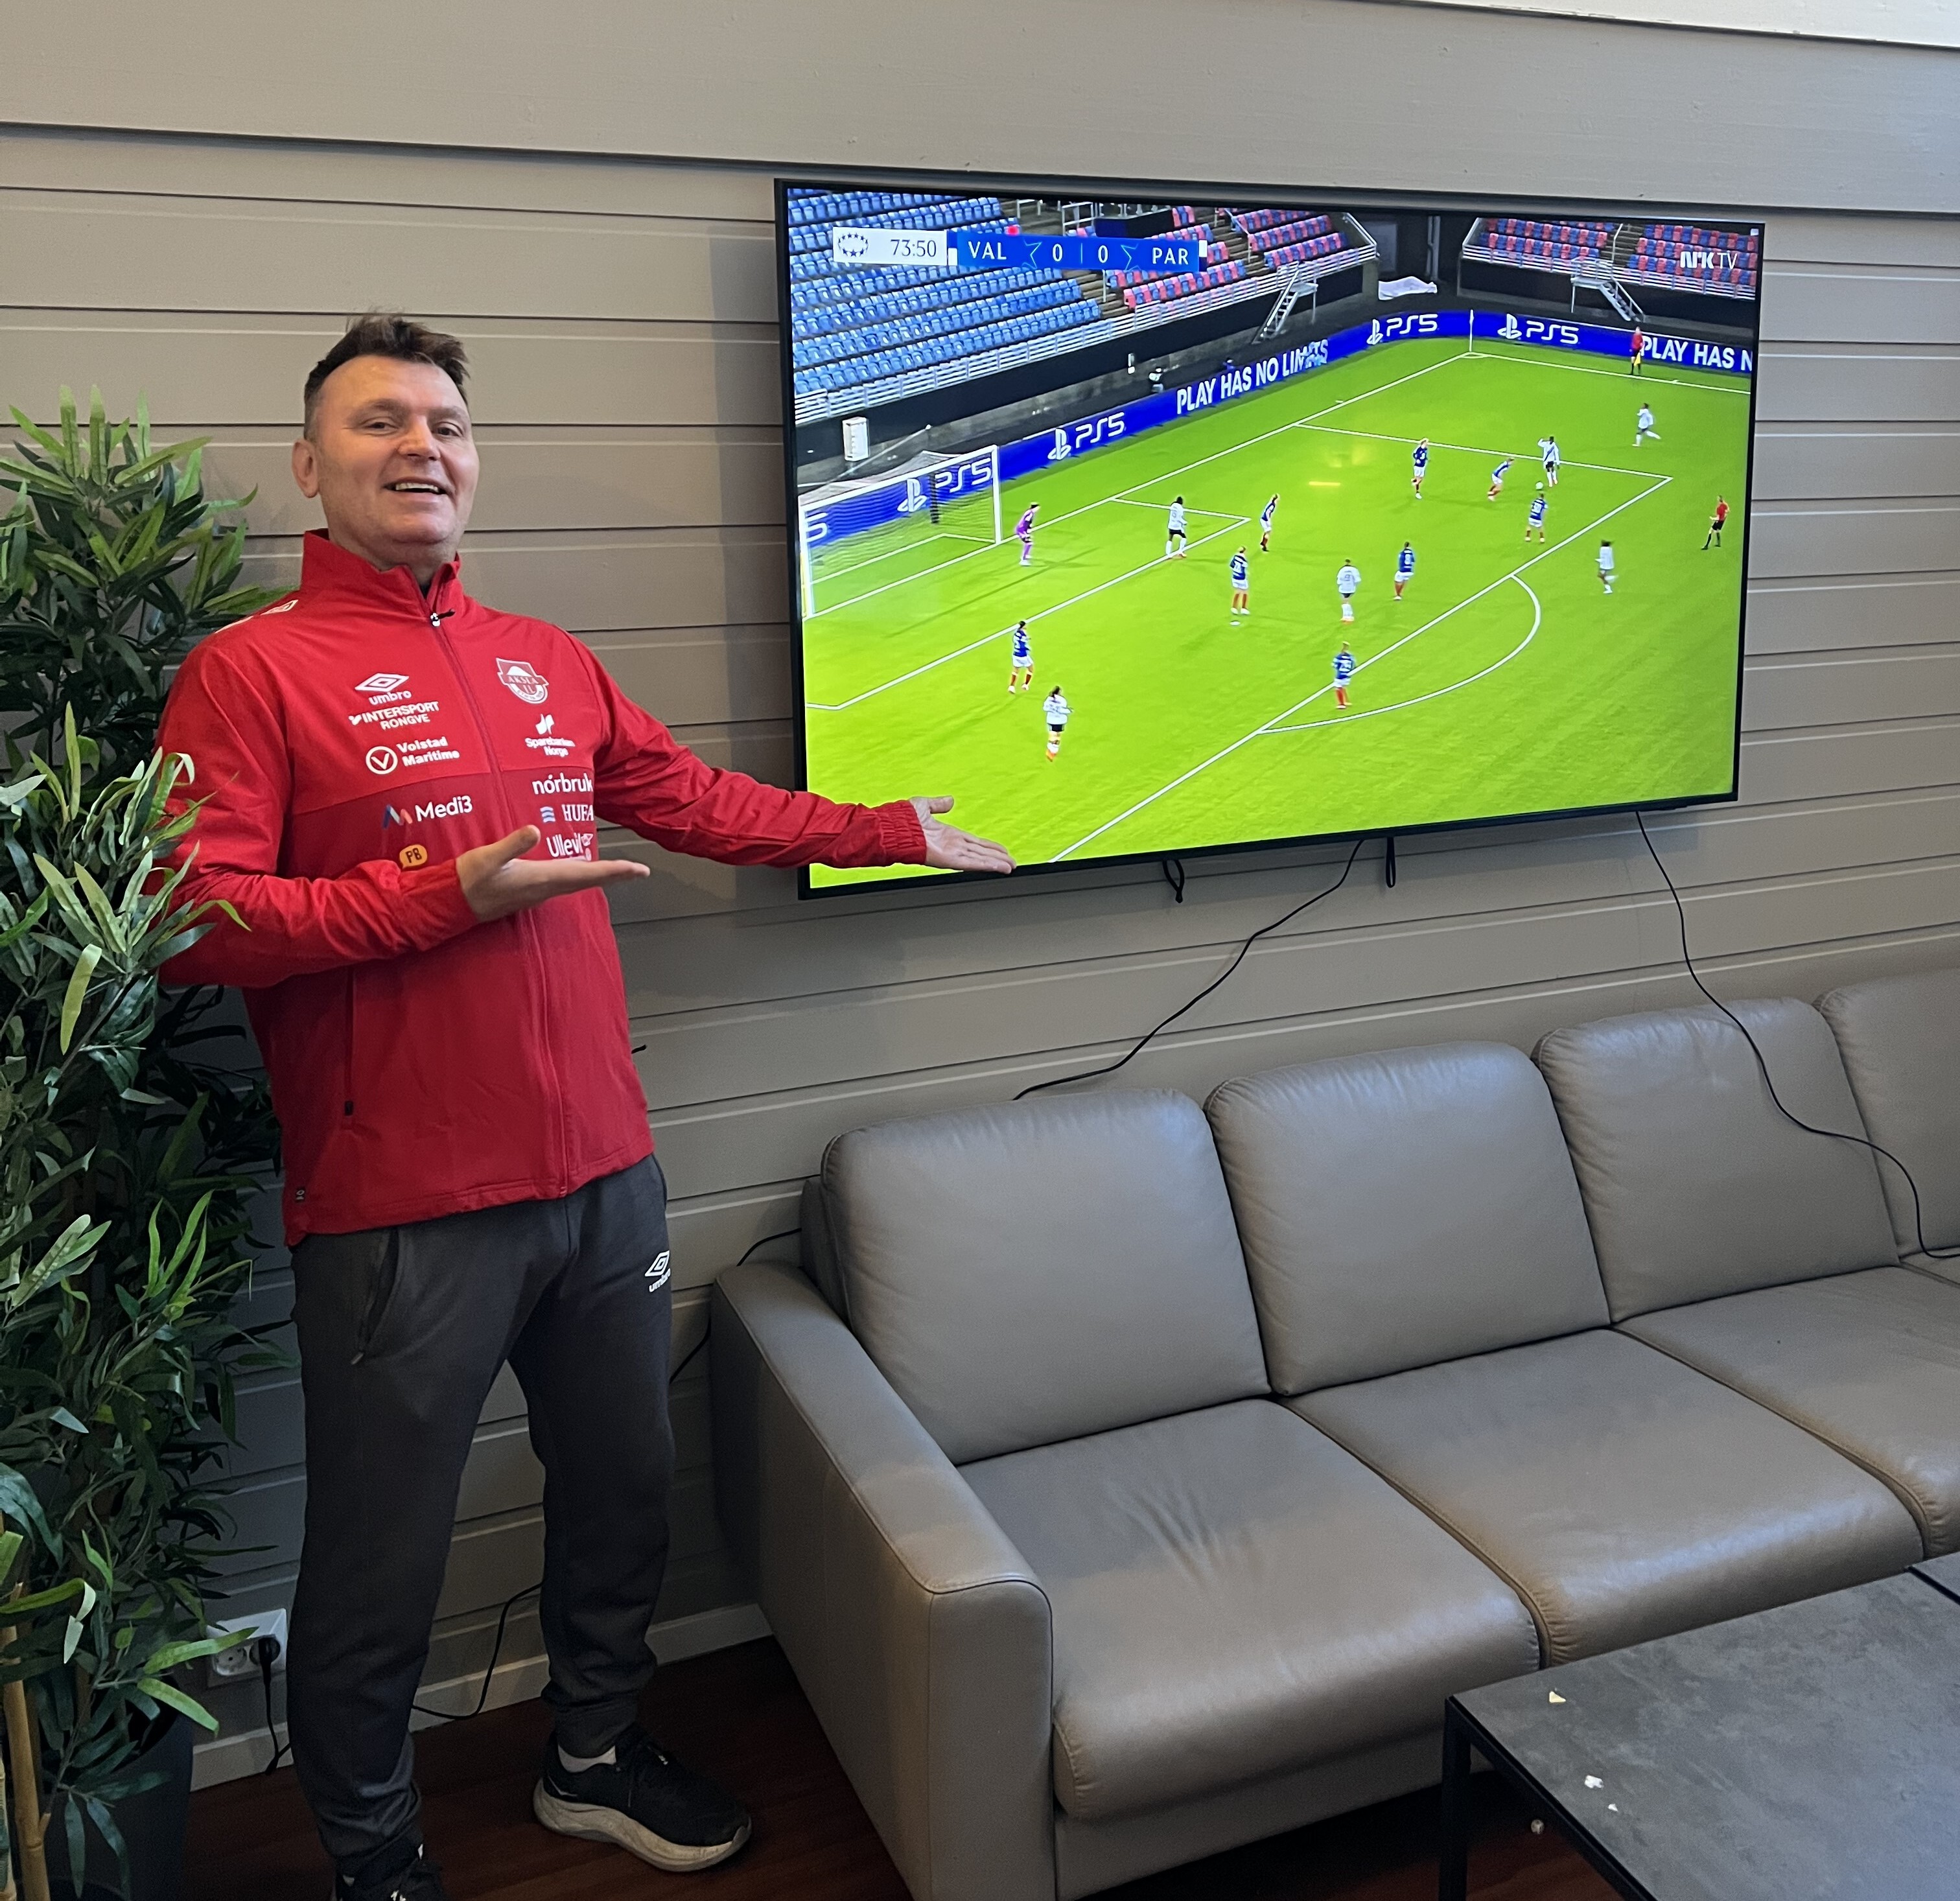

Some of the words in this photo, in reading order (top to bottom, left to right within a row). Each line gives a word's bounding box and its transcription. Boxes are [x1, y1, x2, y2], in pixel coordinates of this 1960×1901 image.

[890, 239, 937, 257] 73:50
[968, 241, 1007, 260] VAL
[1052, 243, 1064, 262] 0
[1097, 245, 1108, 263] 0
[1152, 247, 1189, 265] PAR
[1680, 251, 1714, 269] NRK
[1717, 252, 1738, 270] TV
[1386, 314, 1438, 336] PS5
[1526, 320, 1580, 345] PS5
[1640, 335, 1688, 362] PLAY
[1694, 343, 1735, 369] HAS
[1176, 378, 1217, 415] PLAY
[1220, 366, 1252, 399] HAS
[1255, 357, 1279, 386] NO
[1075, 412, 1125, 449] PS5
[935, 457, 992, 493] PS5
[368, 690, 412, 705] umbro
[362, 701, 439, 723] INTERSPORT
[380, 714, 431, 730] RONGVE
[396, 736, 449, 753] Volstad
[402, 750, 460, 767] Maritime
[415, 795, 473, 822] Medi3
